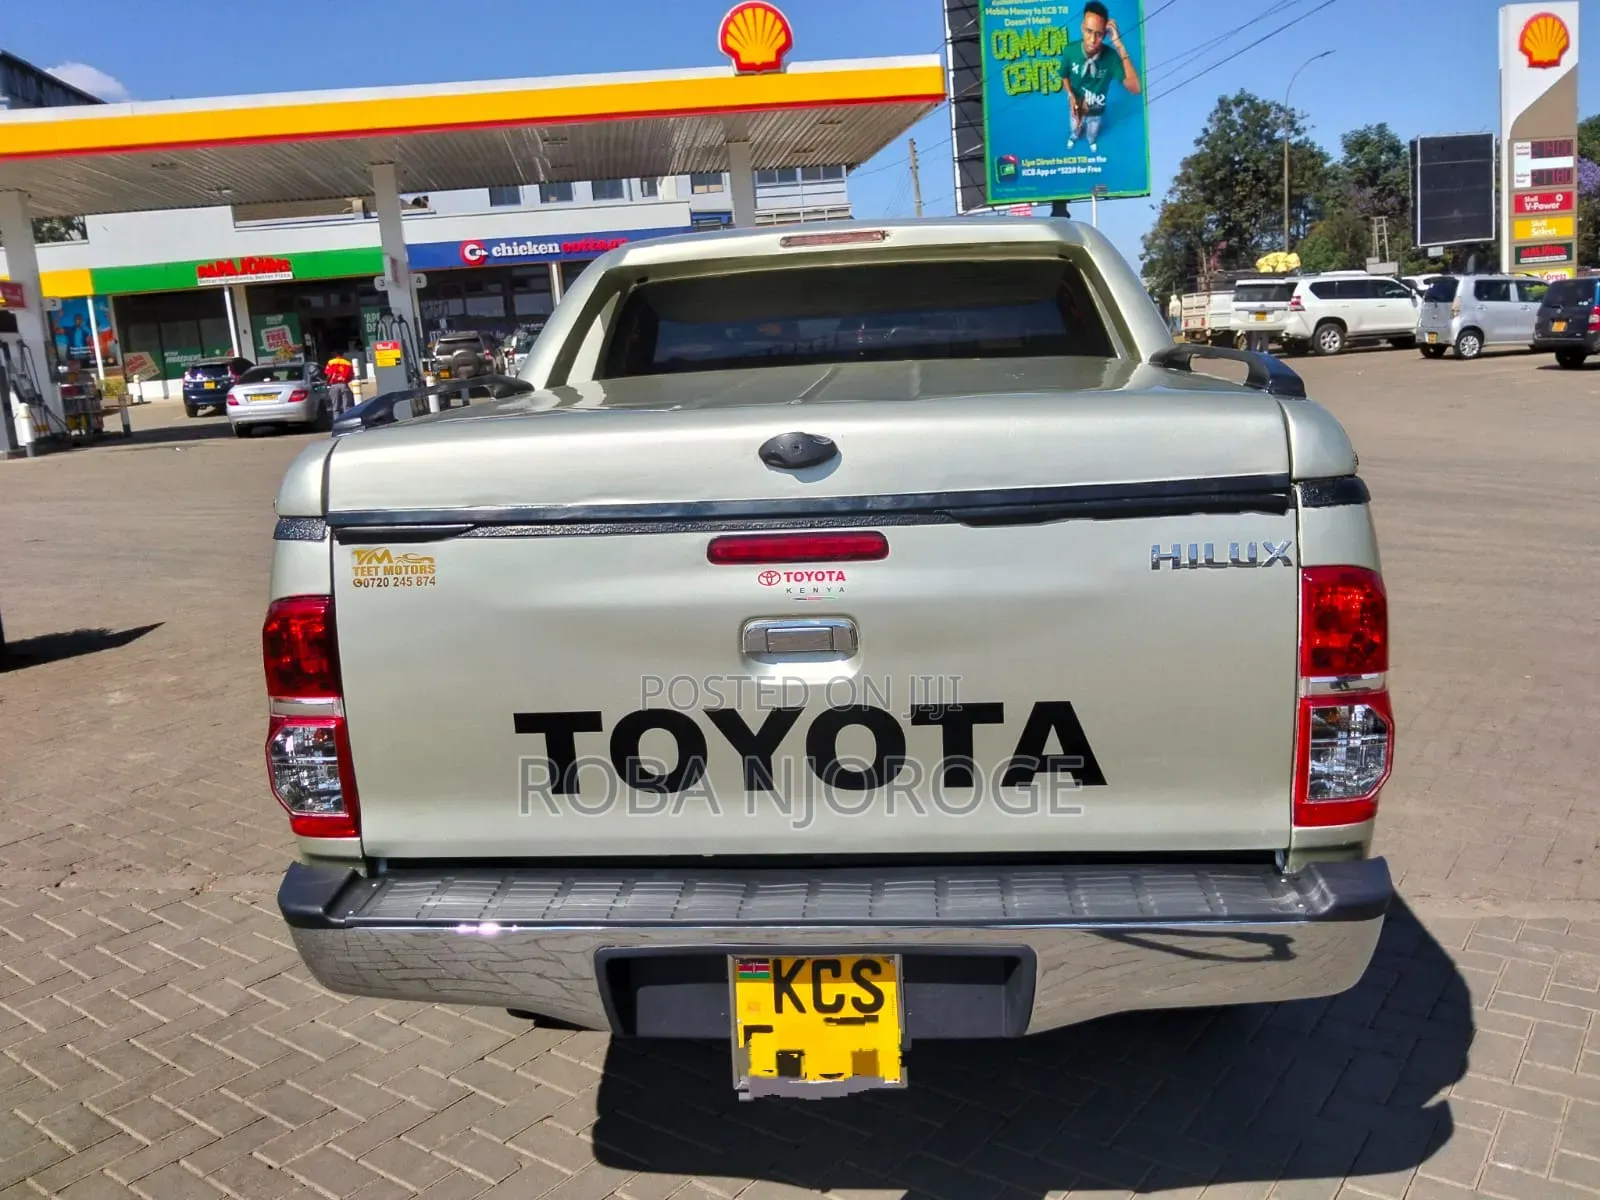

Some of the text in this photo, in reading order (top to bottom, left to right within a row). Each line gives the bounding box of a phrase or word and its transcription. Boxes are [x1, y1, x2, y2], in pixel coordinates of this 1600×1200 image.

[1010, 7, 1032, 16] Money
[1042, 6, 1057, 14] KCB
[1058, 6, 1069, 14] Till
[1004, 17, 1031, 26] Doesn't
[991, 26, 1068, 60] COMMON
[1003, 58, 1063, 95] CENTS
[1525, 202, 1560, 211] V-Power
[491, 241, 560, 257] chicken
[1151, 541, 1293, 570] HILUX
[352, 564, 436, 577] TEET MOTORS
[784, 570, 846, 582] TOYOTA
[363, 575, 436, 588] 0720 245 874
[513, 701, 1108, 794] TOYOTA
[772, 958, 885, 1014] KCS
